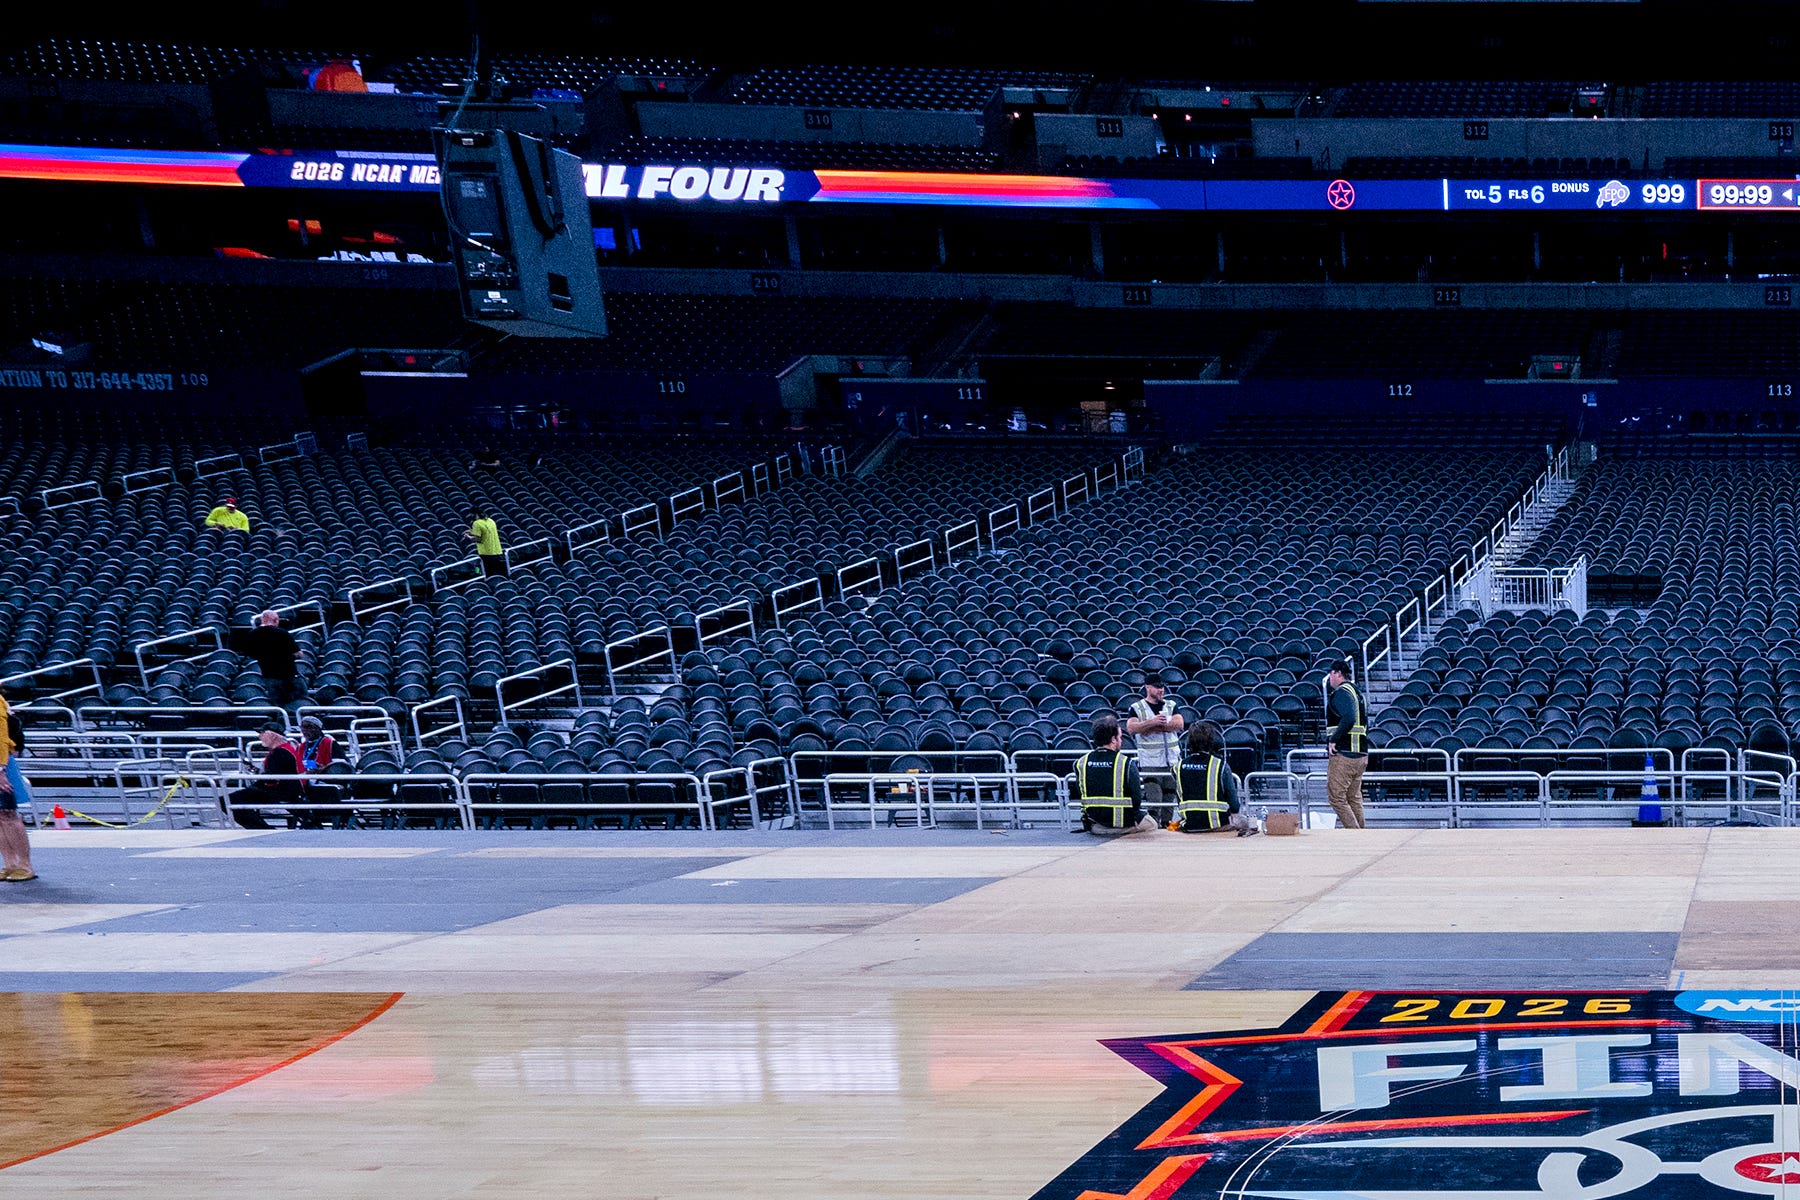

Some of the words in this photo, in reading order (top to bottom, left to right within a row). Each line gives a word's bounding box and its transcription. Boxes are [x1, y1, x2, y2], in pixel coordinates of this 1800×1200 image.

[806, 113, 830, 126] 310
[1099, 122, 1121, 134] 311
[1465, 124, 1487, 137] 312
[1769, 125, 1792, 137] 313
[290, 161, 345, 181] 2026
[637, 166, 785, 201] FOUR
[1551, 182, 1590, 193] BONUS
[1464, 189, 1486, 200] TOL
[1488, 185, 1502, 204] 5
[1508, 189, 1529, 200] FLS
[1531, 185, 1545, 204] 6
[1604, 188, 1626, 200] FPO
[1642, 183, 1685, 203] 999
[1710, 185, 1773, 205] 99:99
[754, 277, 778, 289] 210
[1124, 289, 1149, 301] 211
[1435, 289, 1459, 301] 212
[1767, 290, 1789, 301] 213
[45, 370, 68, 389] TO
[71, 371, 175, 391] 317-644-4357
[181, 373, 209, 386] 109
[658, 381, 686, 393] 110
[957, 387, 982, 400] 111
[1388, 384, 1413, 397] 112
[1767, 384, 1792, 397] 113
[1378, 999, 1632, 1023] 2026
